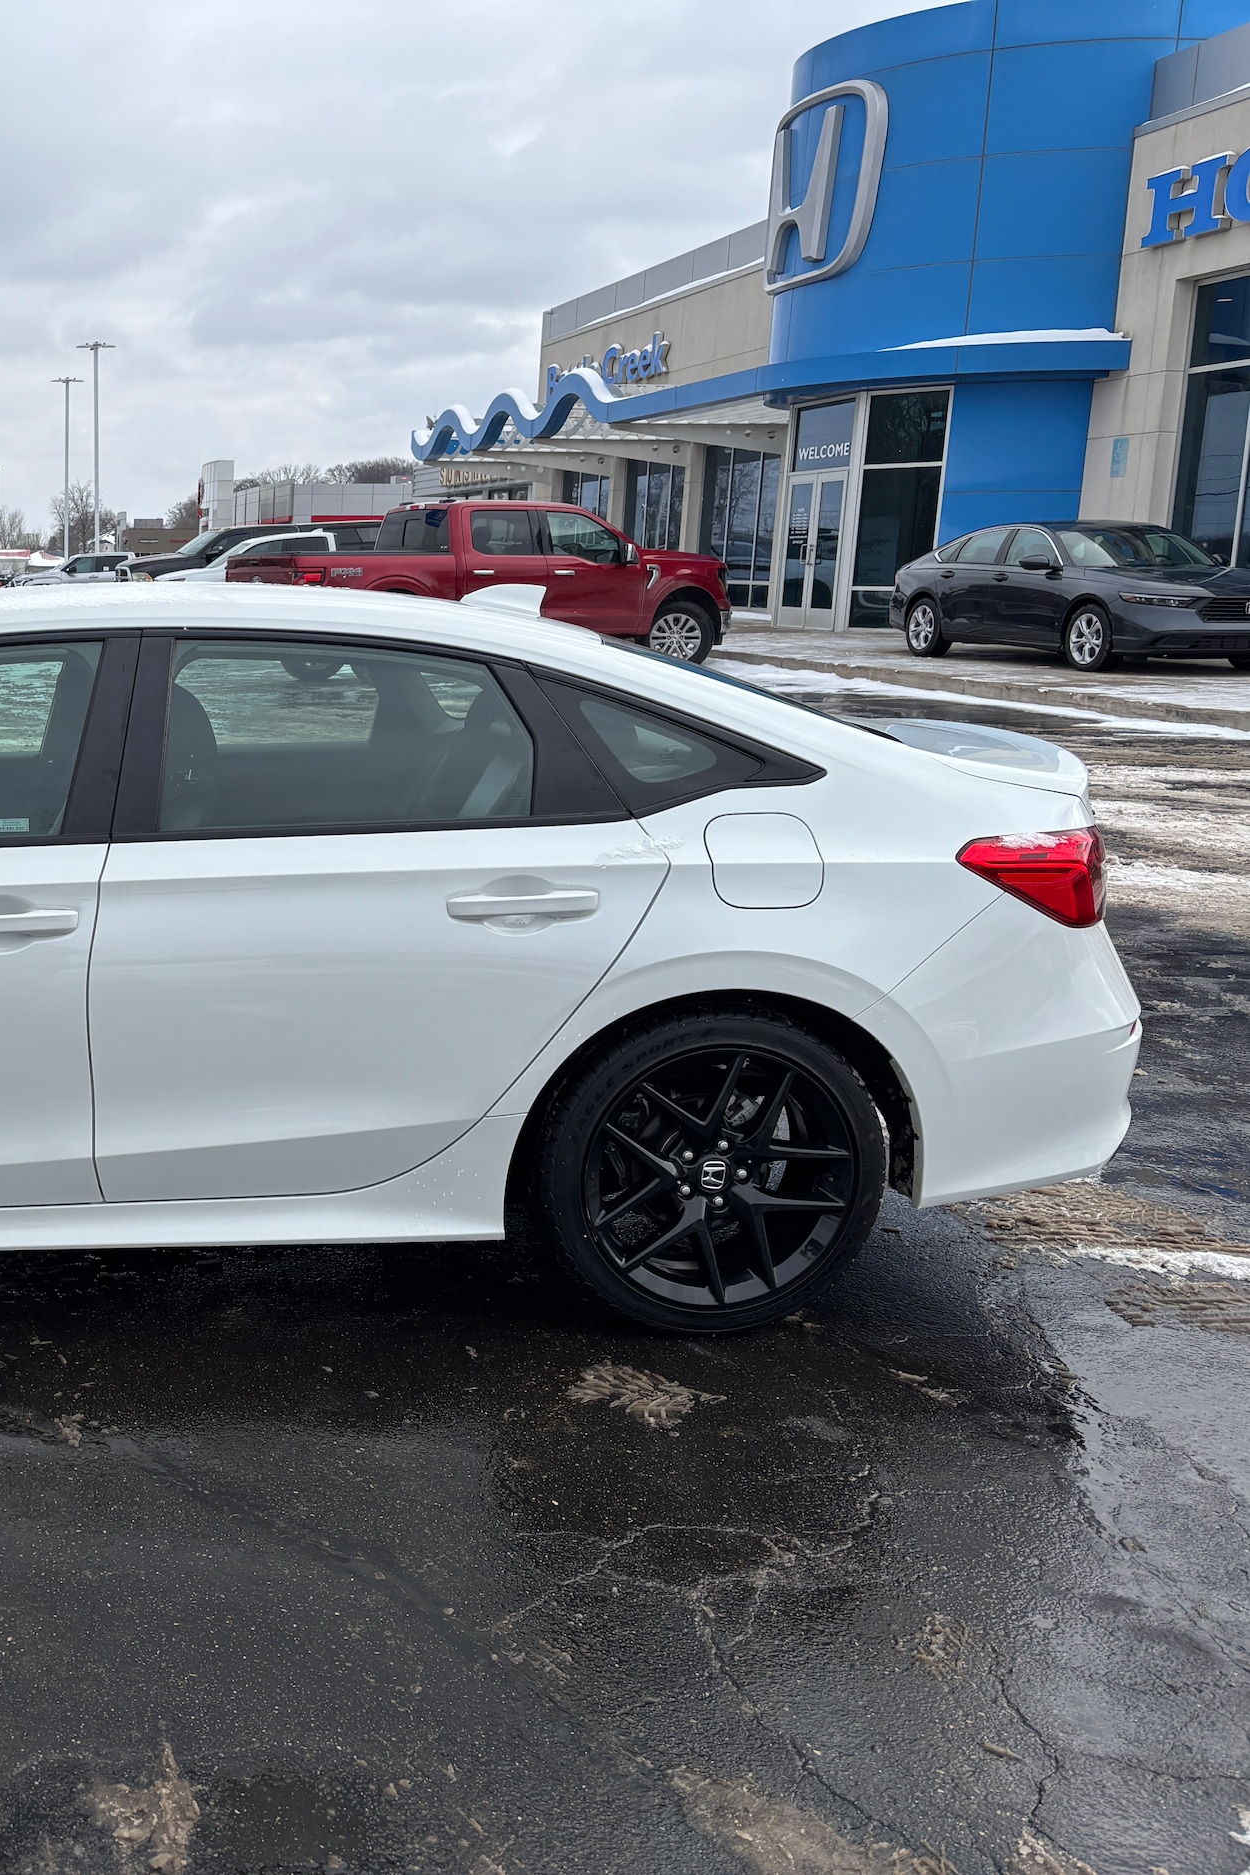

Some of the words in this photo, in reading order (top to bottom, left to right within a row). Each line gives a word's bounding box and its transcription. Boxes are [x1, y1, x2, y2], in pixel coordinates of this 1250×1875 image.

[602, 331, 671, 384] Creek
[798, 442, 851, 461] WELCOME
[570, 1074, 619, 1144] EAGLE
